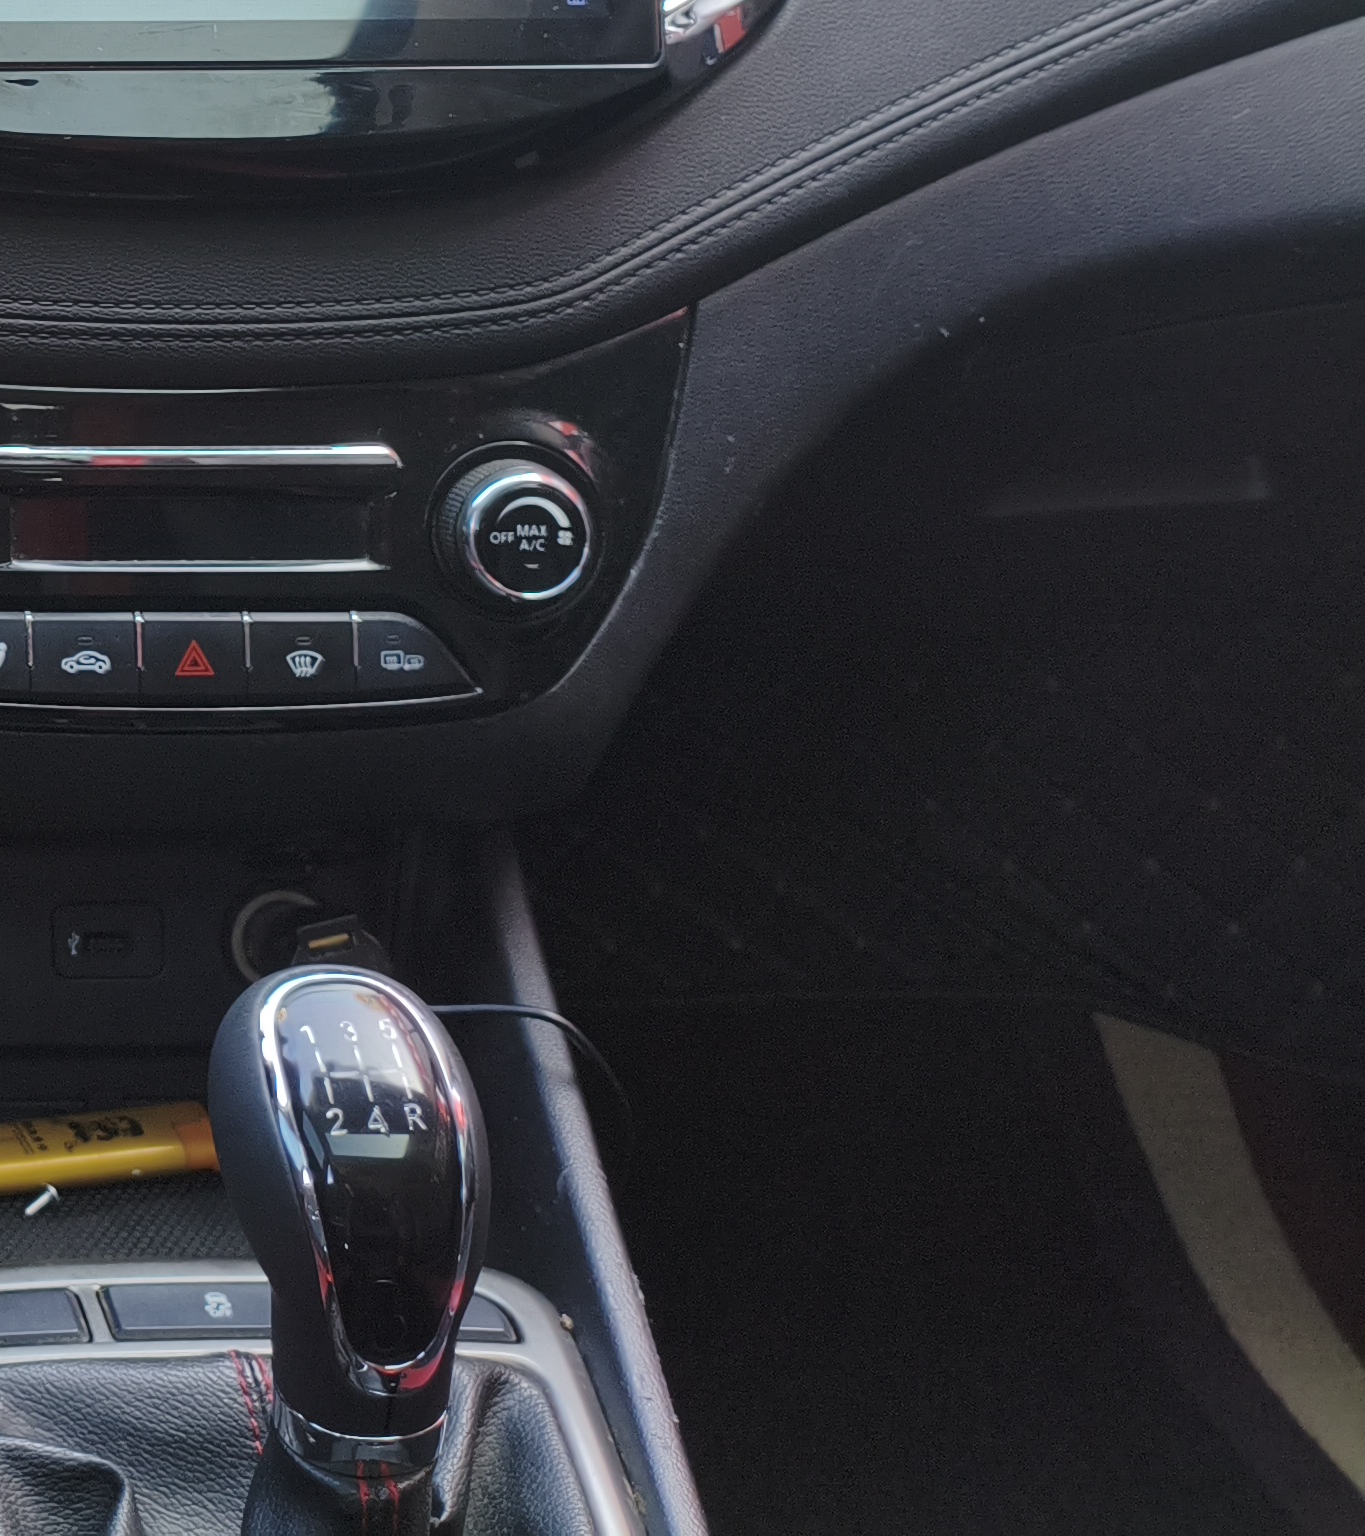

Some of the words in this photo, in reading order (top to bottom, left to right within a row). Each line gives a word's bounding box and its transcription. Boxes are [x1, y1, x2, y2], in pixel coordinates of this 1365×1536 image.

[489, 531, 515, 545] OFF
[516, 524, 548, 538] MAX
[519, 538, 546, 552] A/C
[300, 1025, 316, 1044] 1
[339, 1021, 358, 1042] 3
[378, 1018, 398, 1041] 5
[325, 1107, 349, 1136] 2
[367, 1105, 390, 1135] 4
[403, 1103, 428, 1131] R
